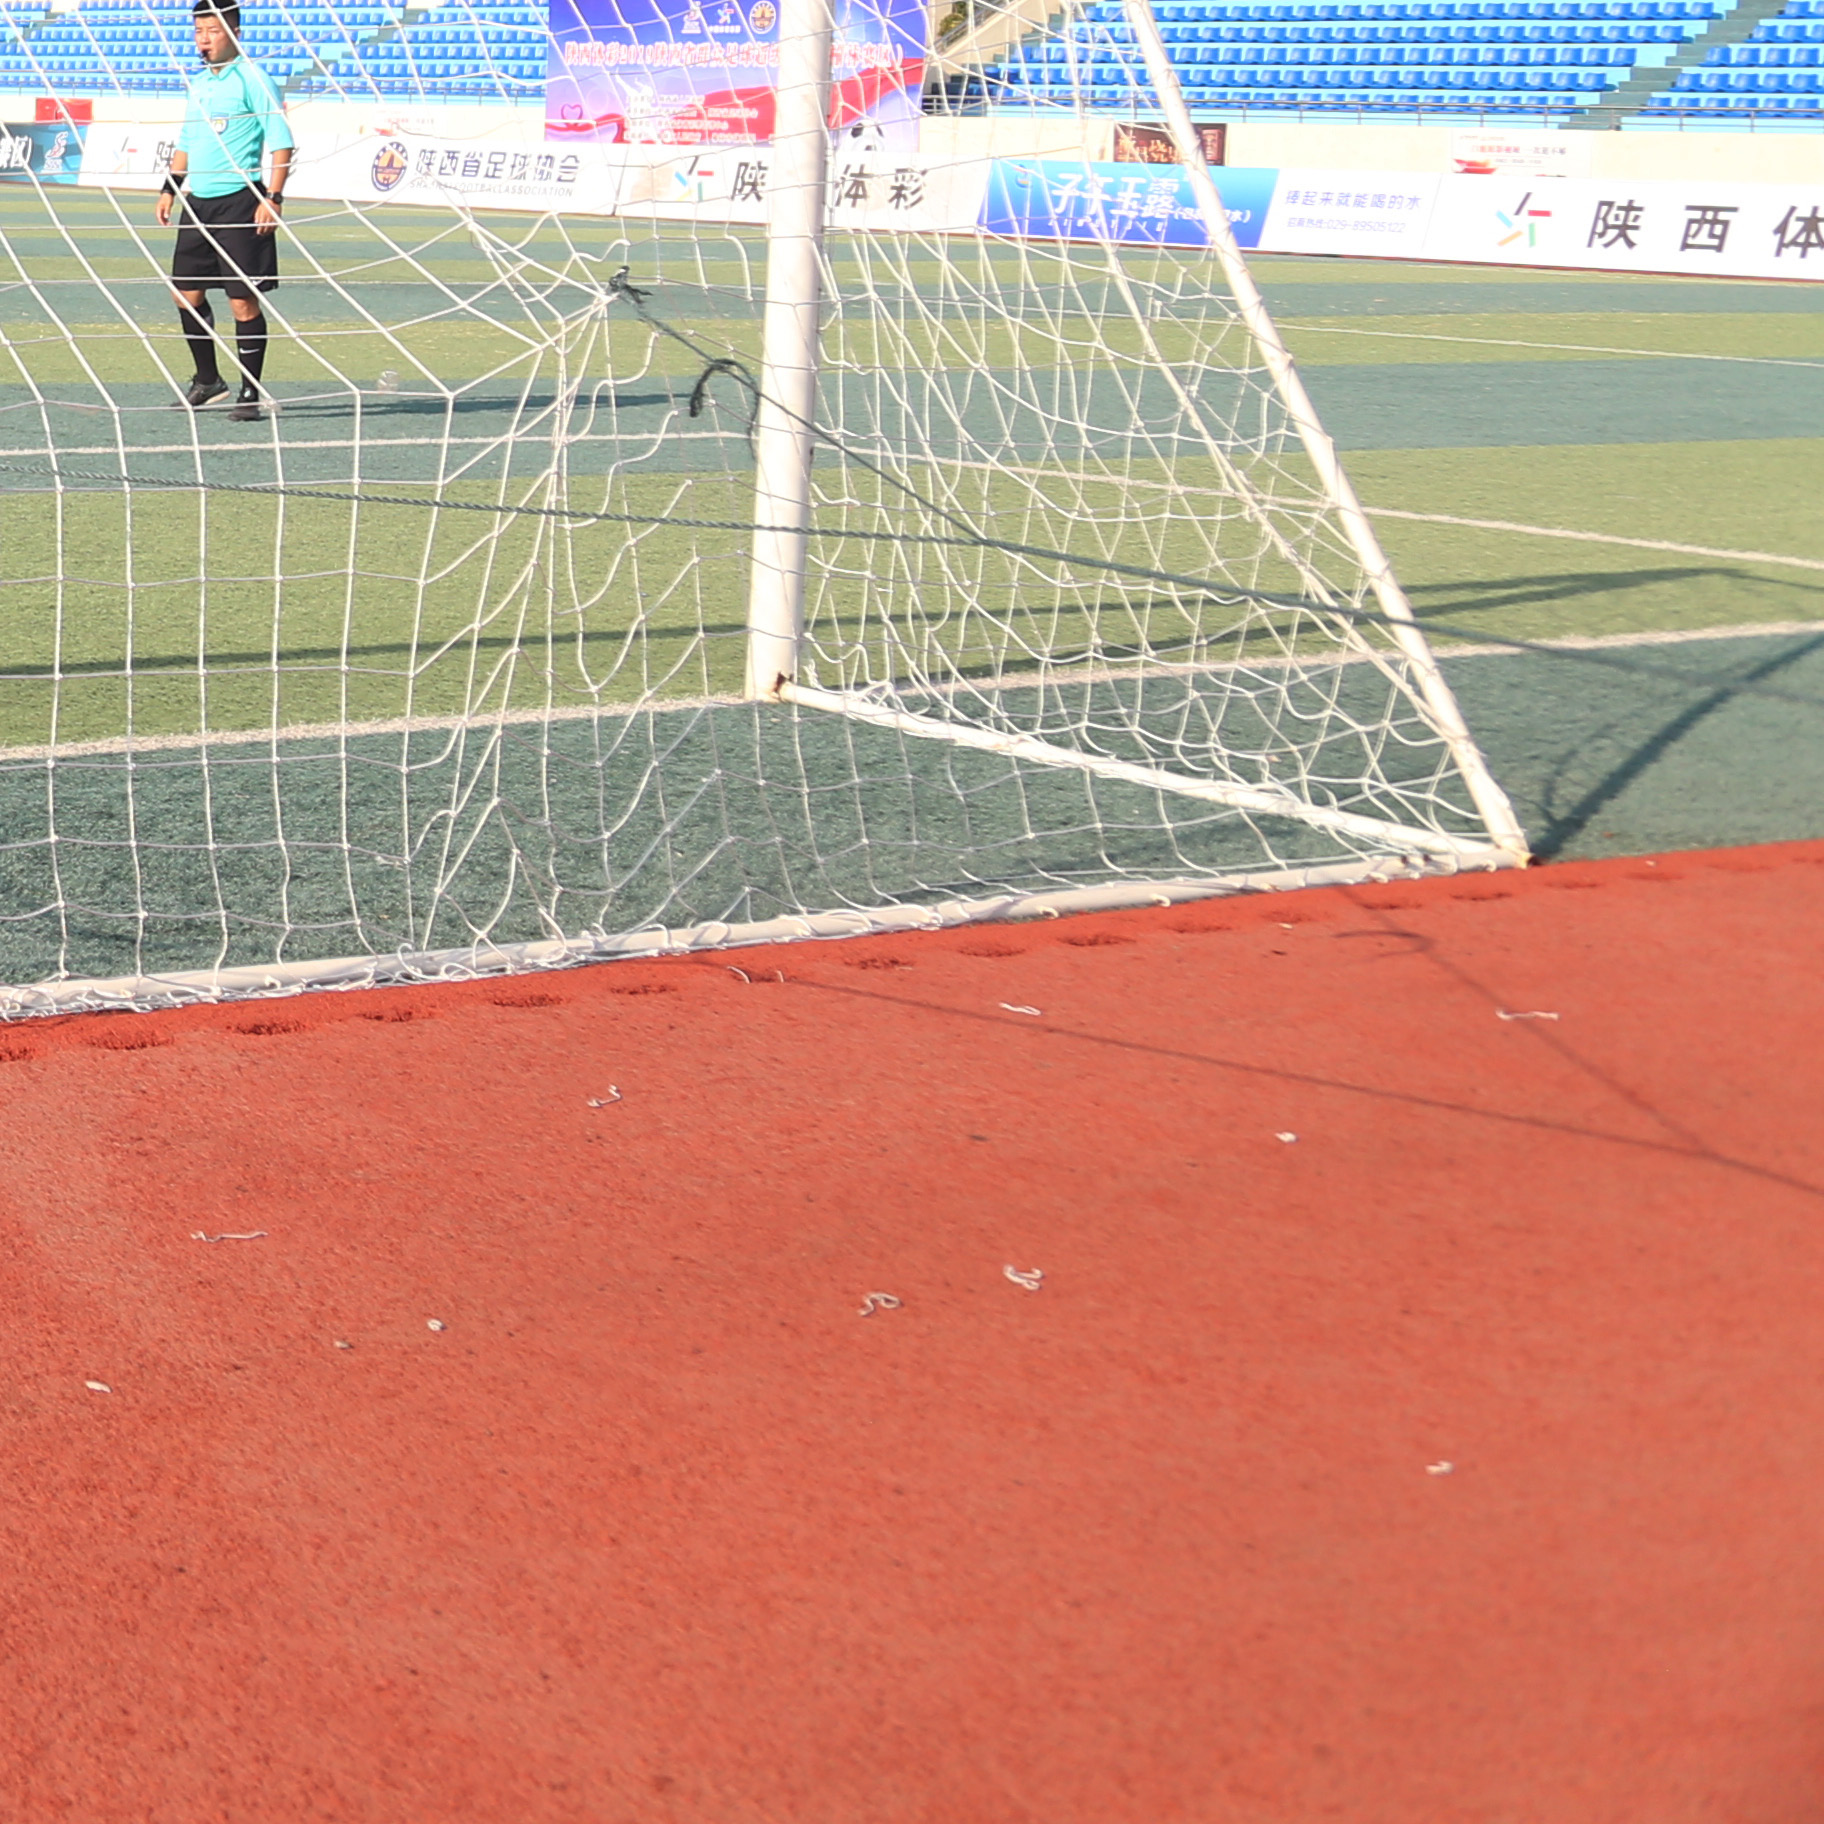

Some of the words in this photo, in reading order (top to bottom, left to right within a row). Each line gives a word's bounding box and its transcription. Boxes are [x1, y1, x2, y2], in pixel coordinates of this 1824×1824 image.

[416, 148, 581, 183] 陕西省足球协会
[731, 160, 927, 211] 陕体彩
[1587, 199, 1824, 259] 陕西体
